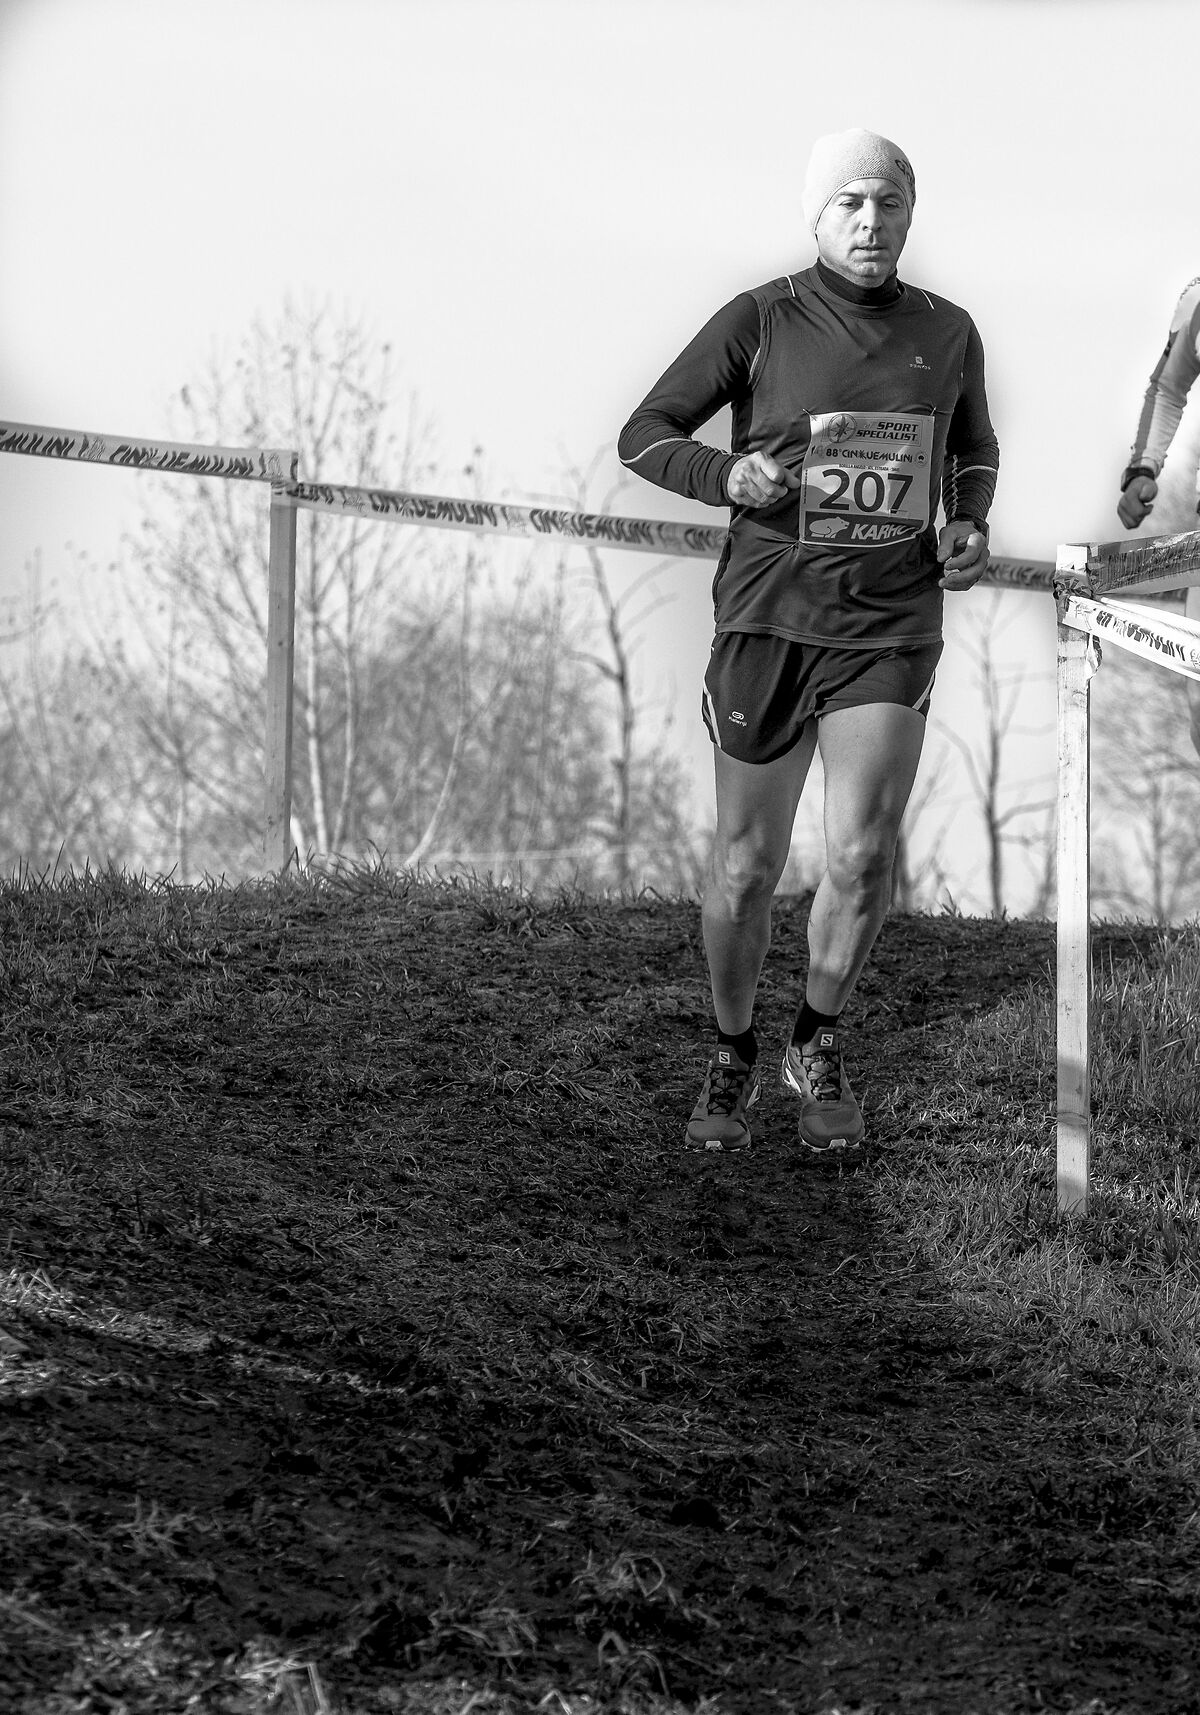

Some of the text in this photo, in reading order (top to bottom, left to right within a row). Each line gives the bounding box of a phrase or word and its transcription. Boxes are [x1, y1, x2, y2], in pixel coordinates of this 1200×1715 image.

[856, 429, 918, 441] SPECIALIST
[877, 421, 919, 433] SPORT
[109, 444, 254, 477] CINUEMULINI
[842, 449, 913, 464] CINUEMULINI
[819, 468, 914, 514] 207
[368, 493, 498, 527] CINUEMULINI
[529, 508, 655, 546] CINUEMULINI
